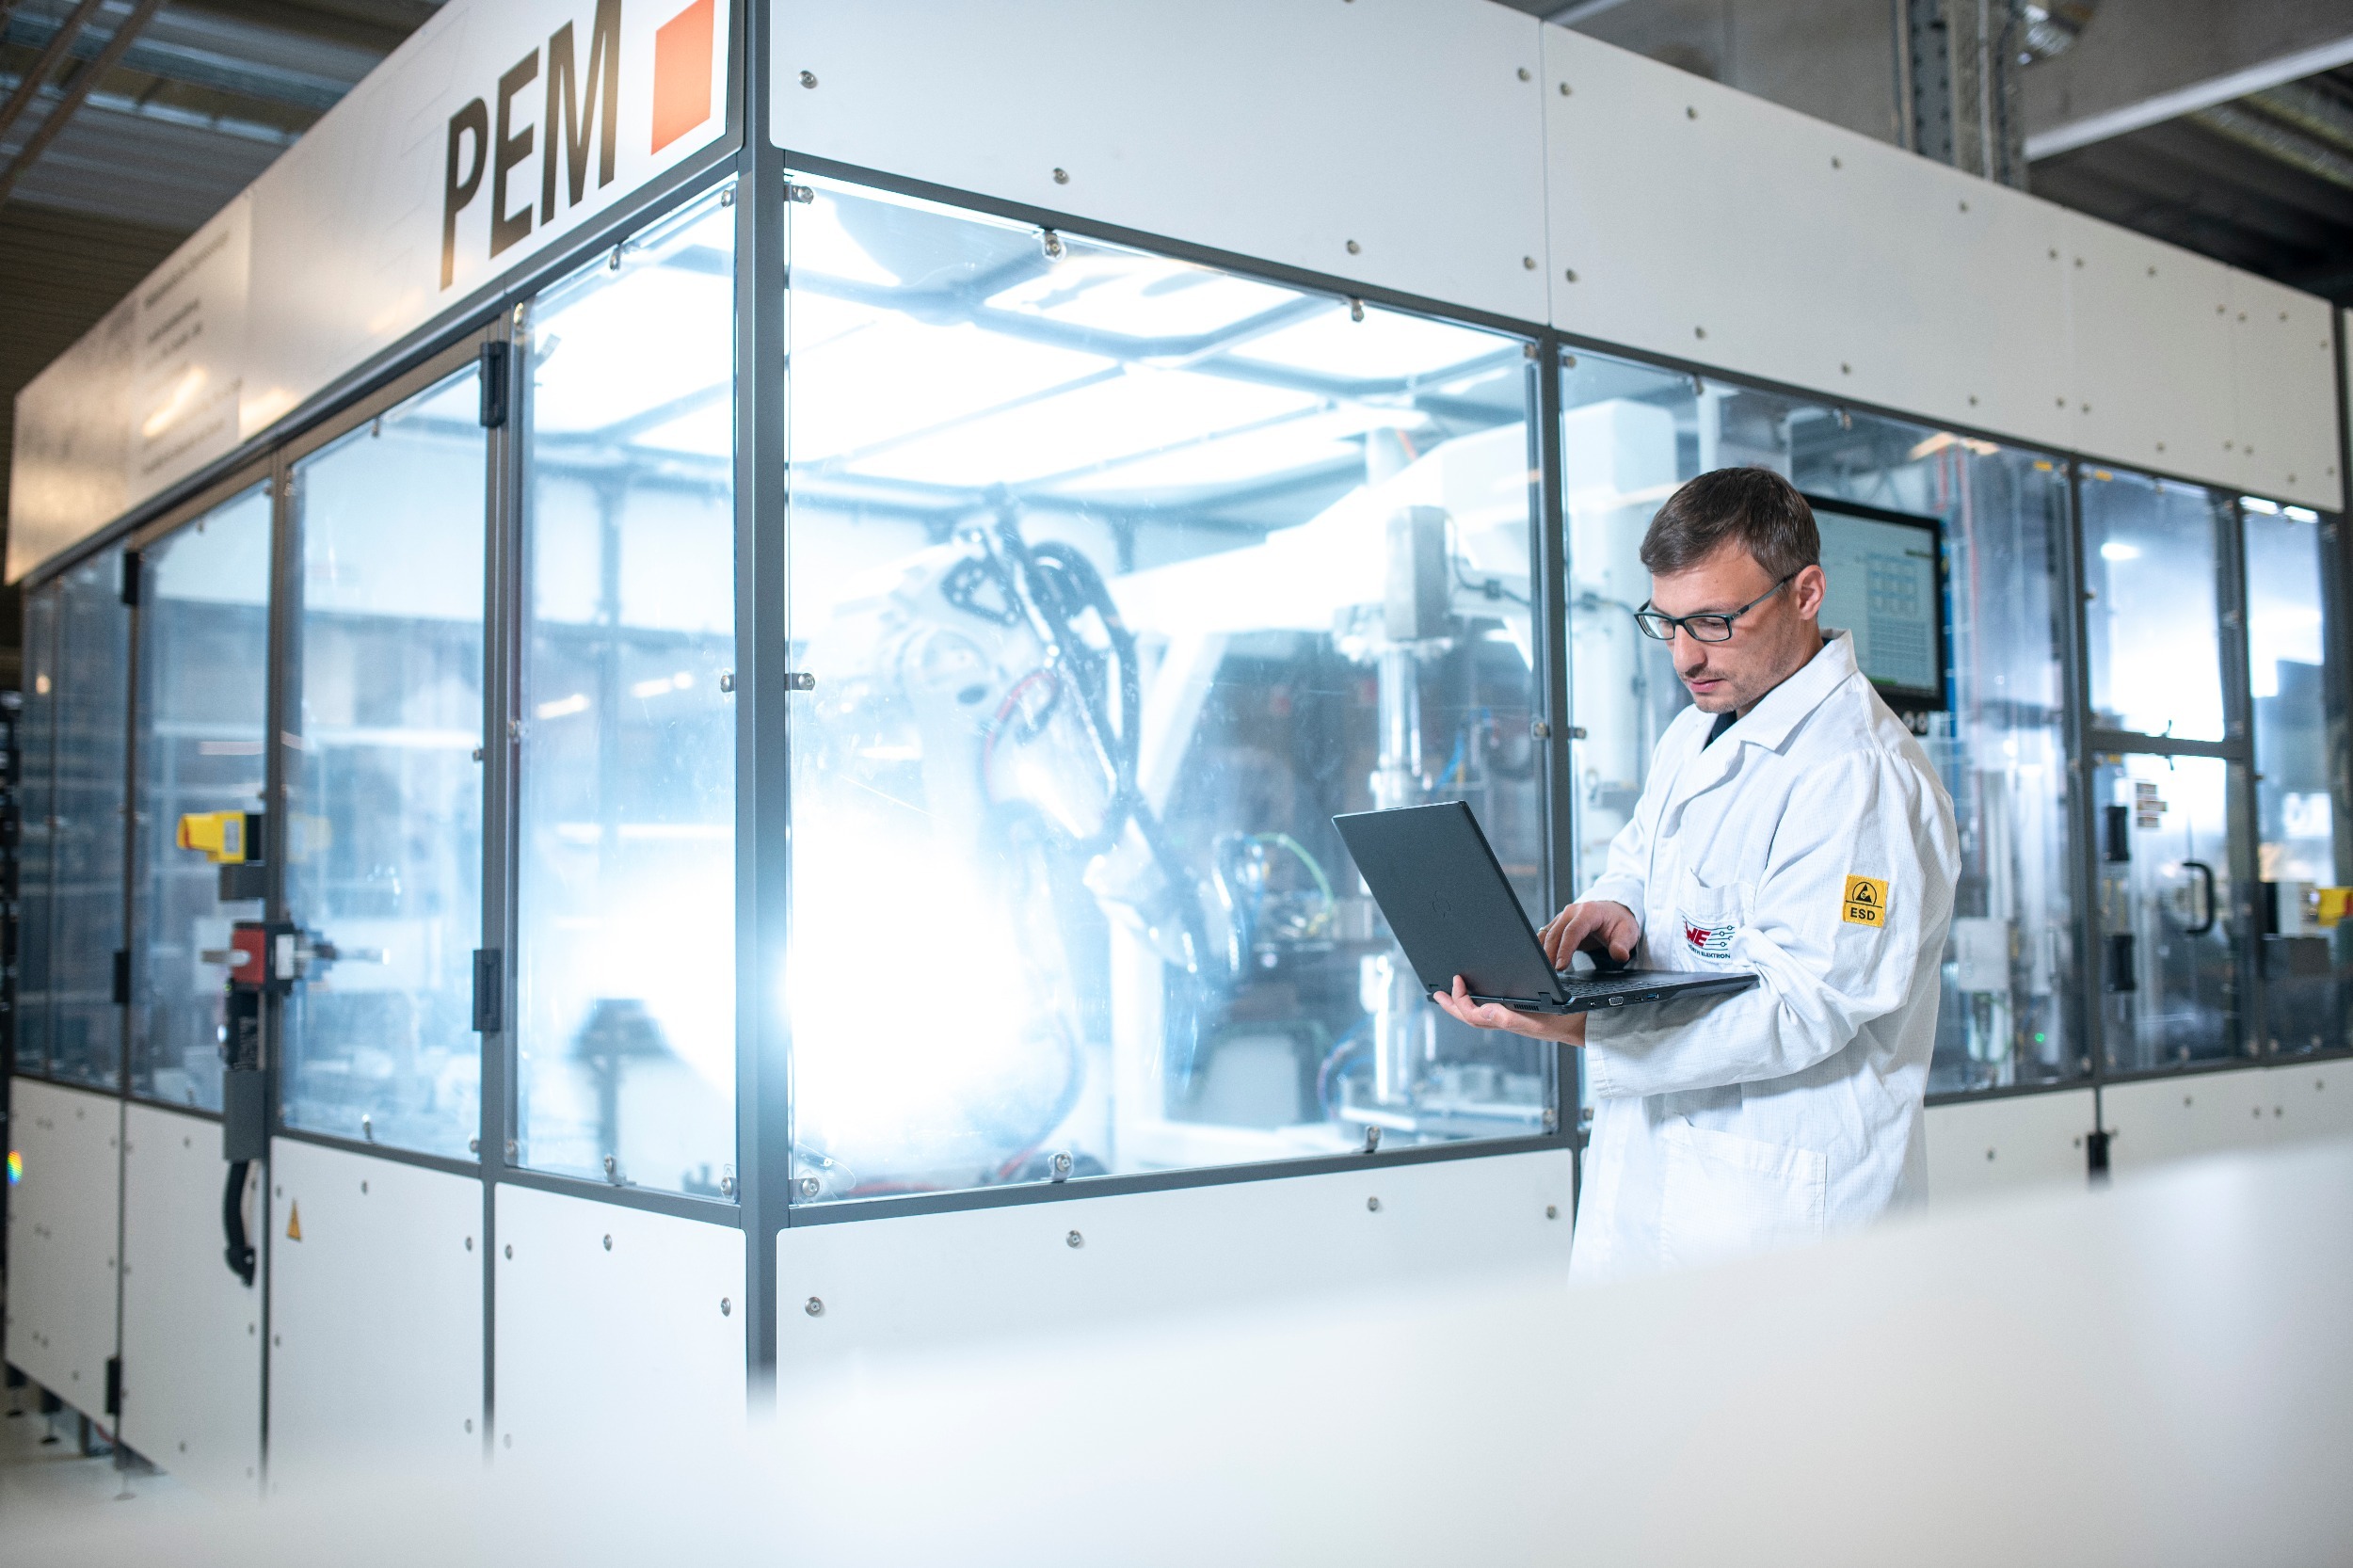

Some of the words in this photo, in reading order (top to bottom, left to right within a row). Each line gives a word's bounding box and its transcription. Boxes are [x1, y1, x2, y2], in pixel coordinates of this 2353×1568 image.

[440, 0, 621, 292] PEM
[1850, 906, 1876, 920] ESD
[1685, 921, 1711, 948] WE
[1701, 951, 1731, 959] ELEKTRON
